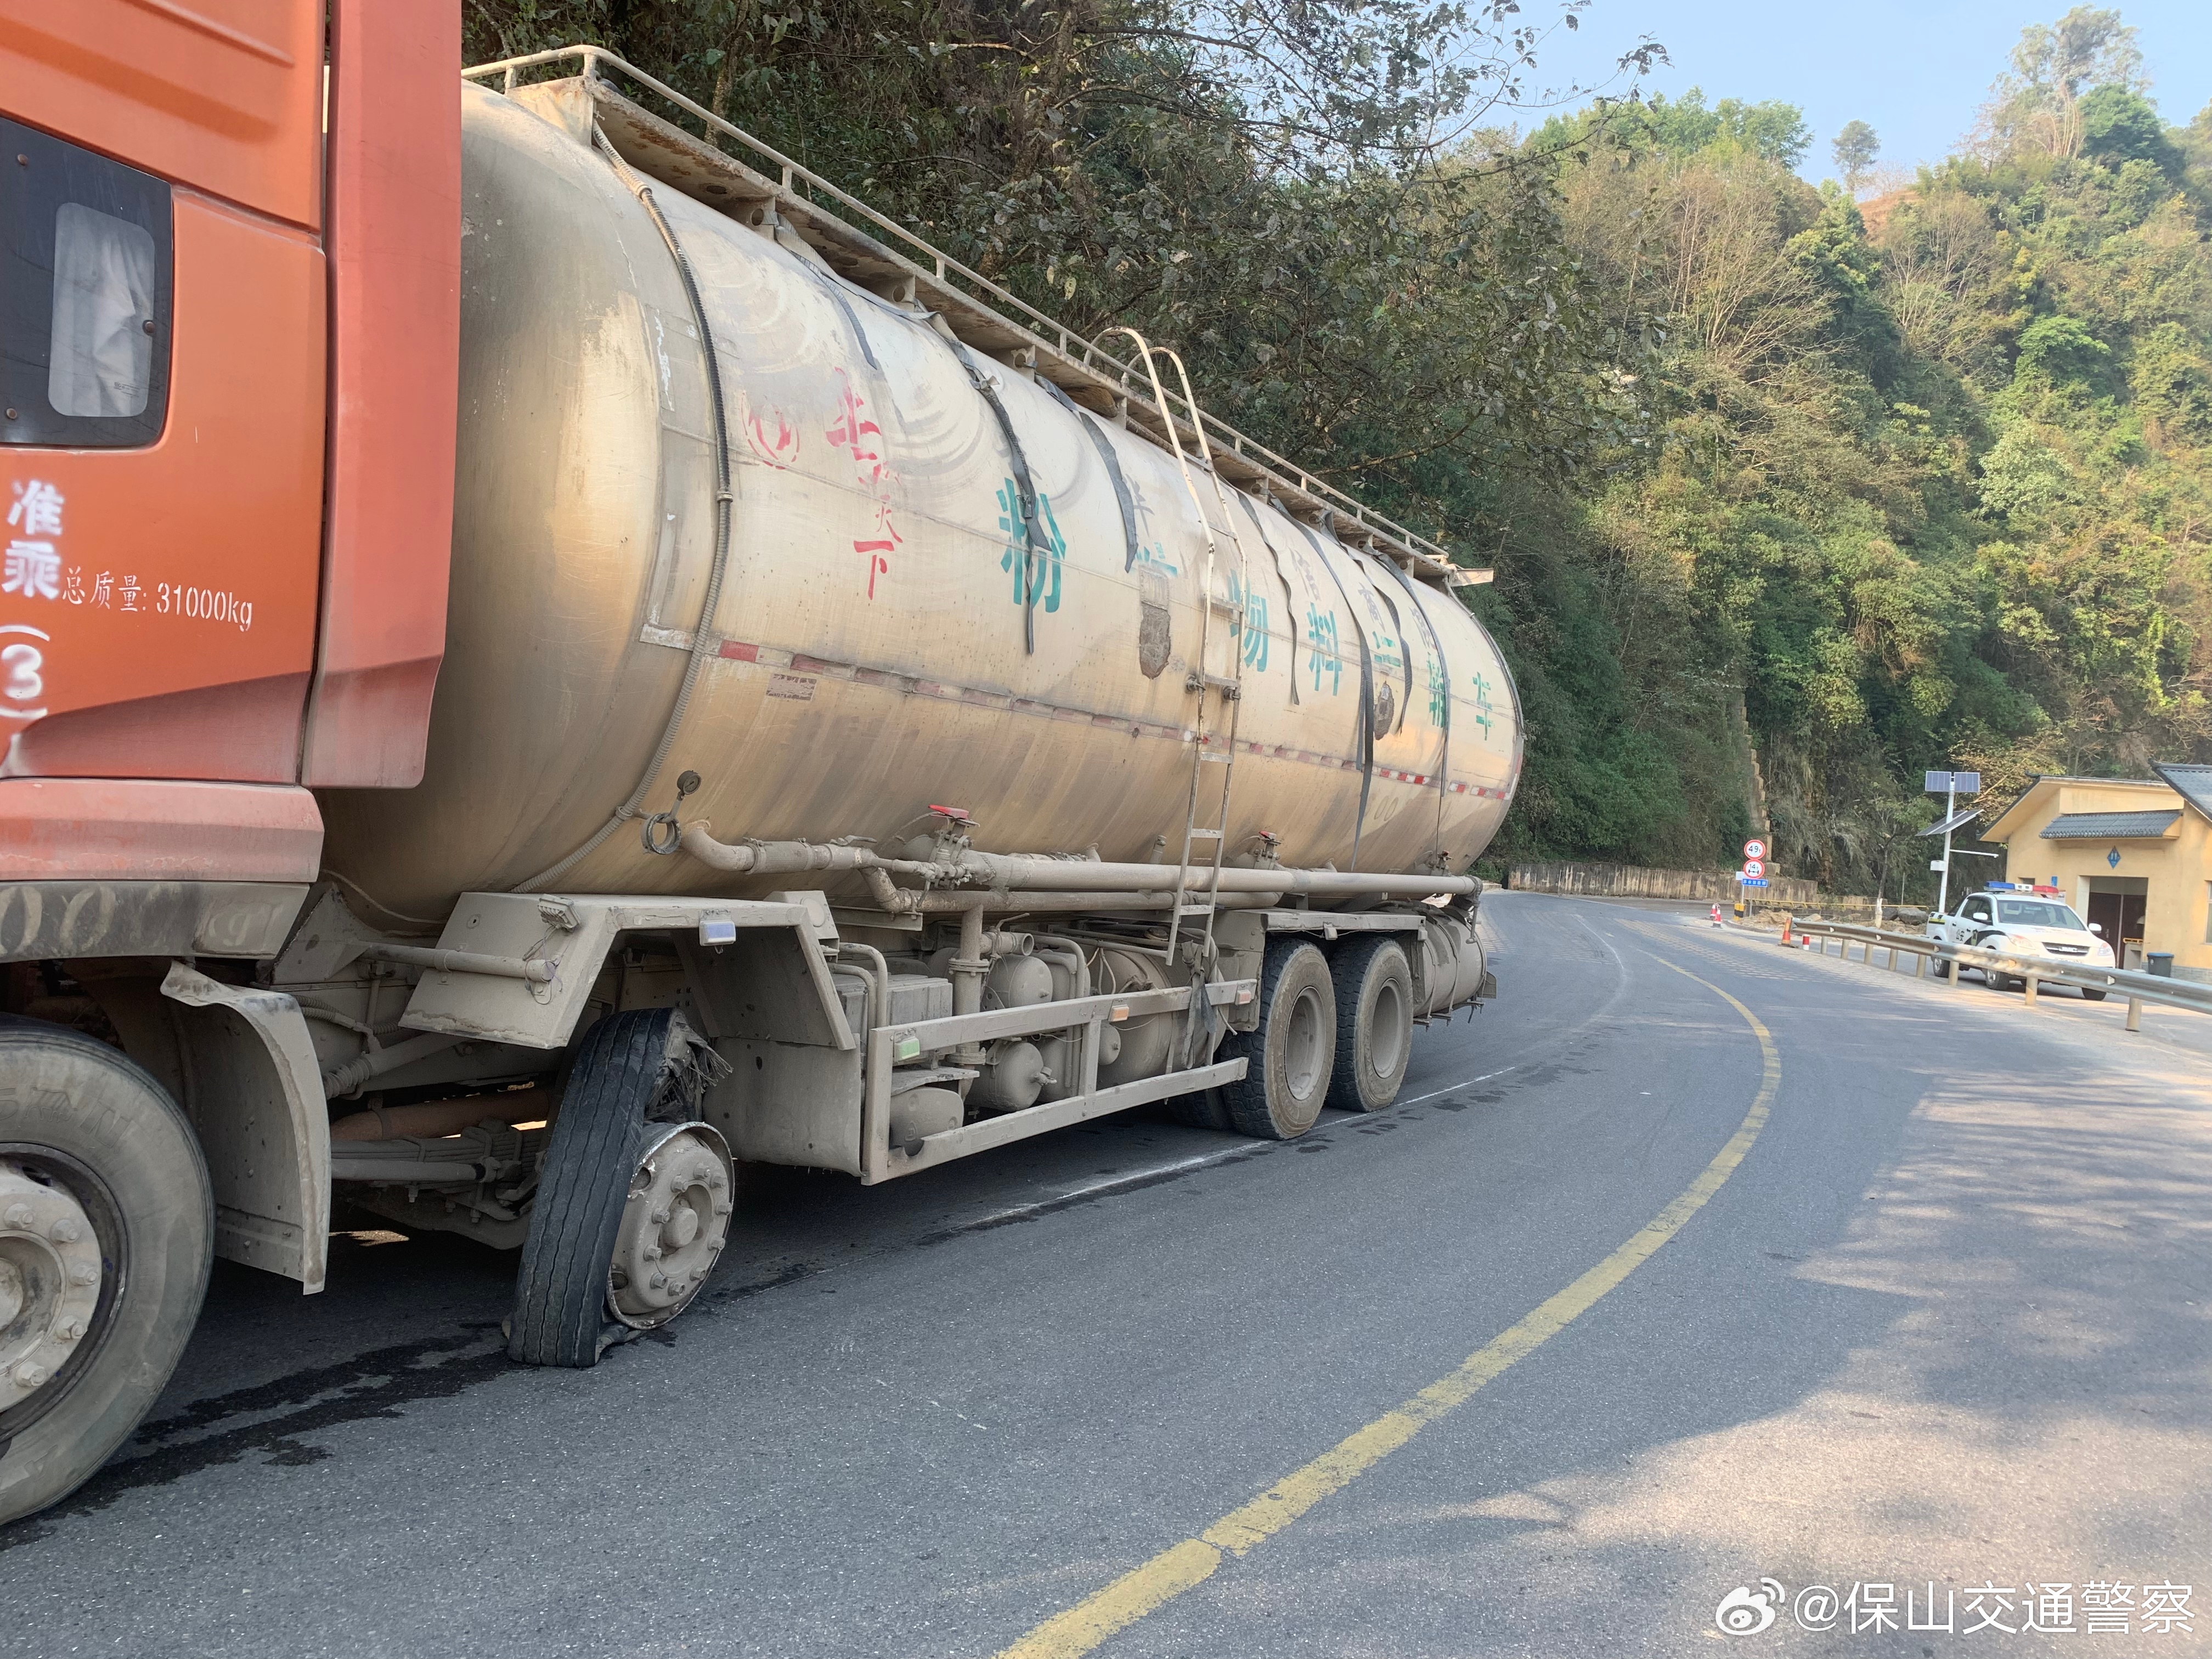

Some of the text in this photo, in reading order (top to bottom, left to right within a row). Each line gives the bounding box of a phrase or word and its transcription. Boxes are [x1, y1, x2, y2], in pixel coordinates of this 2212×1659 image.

[156, 582, 253, 633] 31000kg
[996, 477, 1495, 741] 粉物料输车
